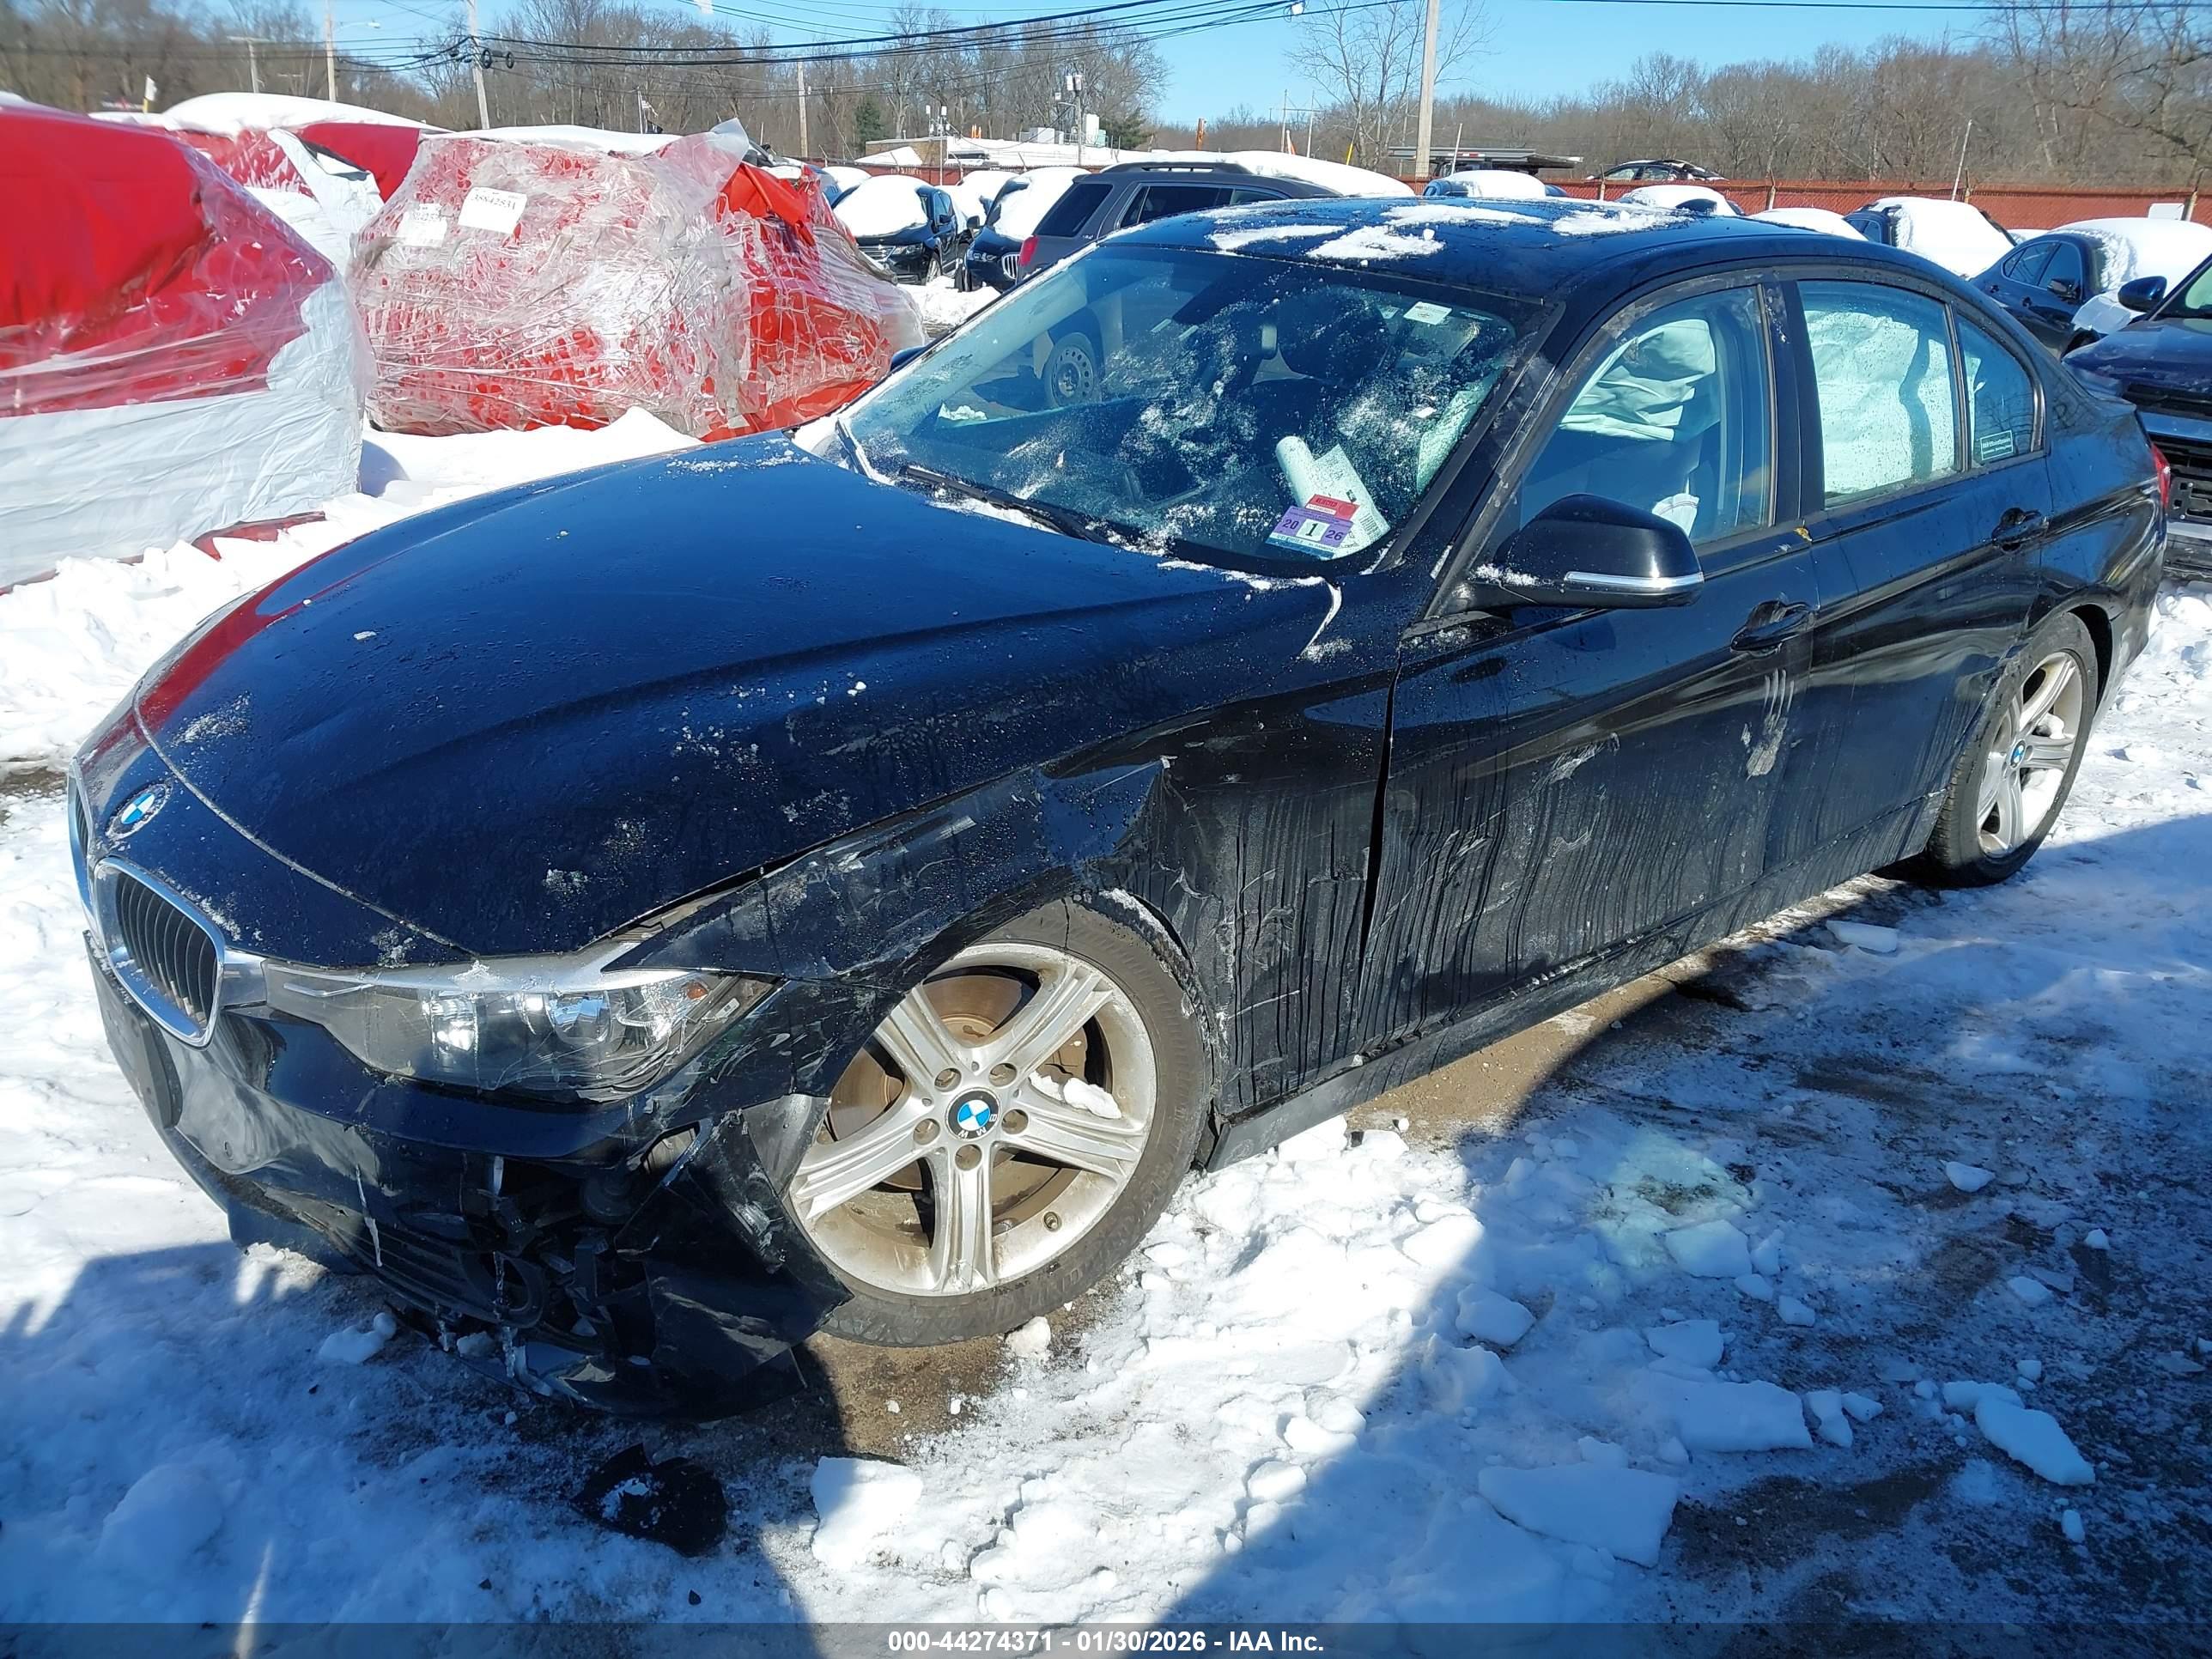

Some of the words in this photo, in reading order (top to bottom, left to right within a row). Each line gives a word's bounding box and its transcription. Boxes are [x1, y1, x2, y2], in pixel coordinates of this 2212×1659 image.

[1283, 519, 1299, 530] 20
[1305, 523, 1318, 537] 1
[1325, 530, 1343, 541] 26
